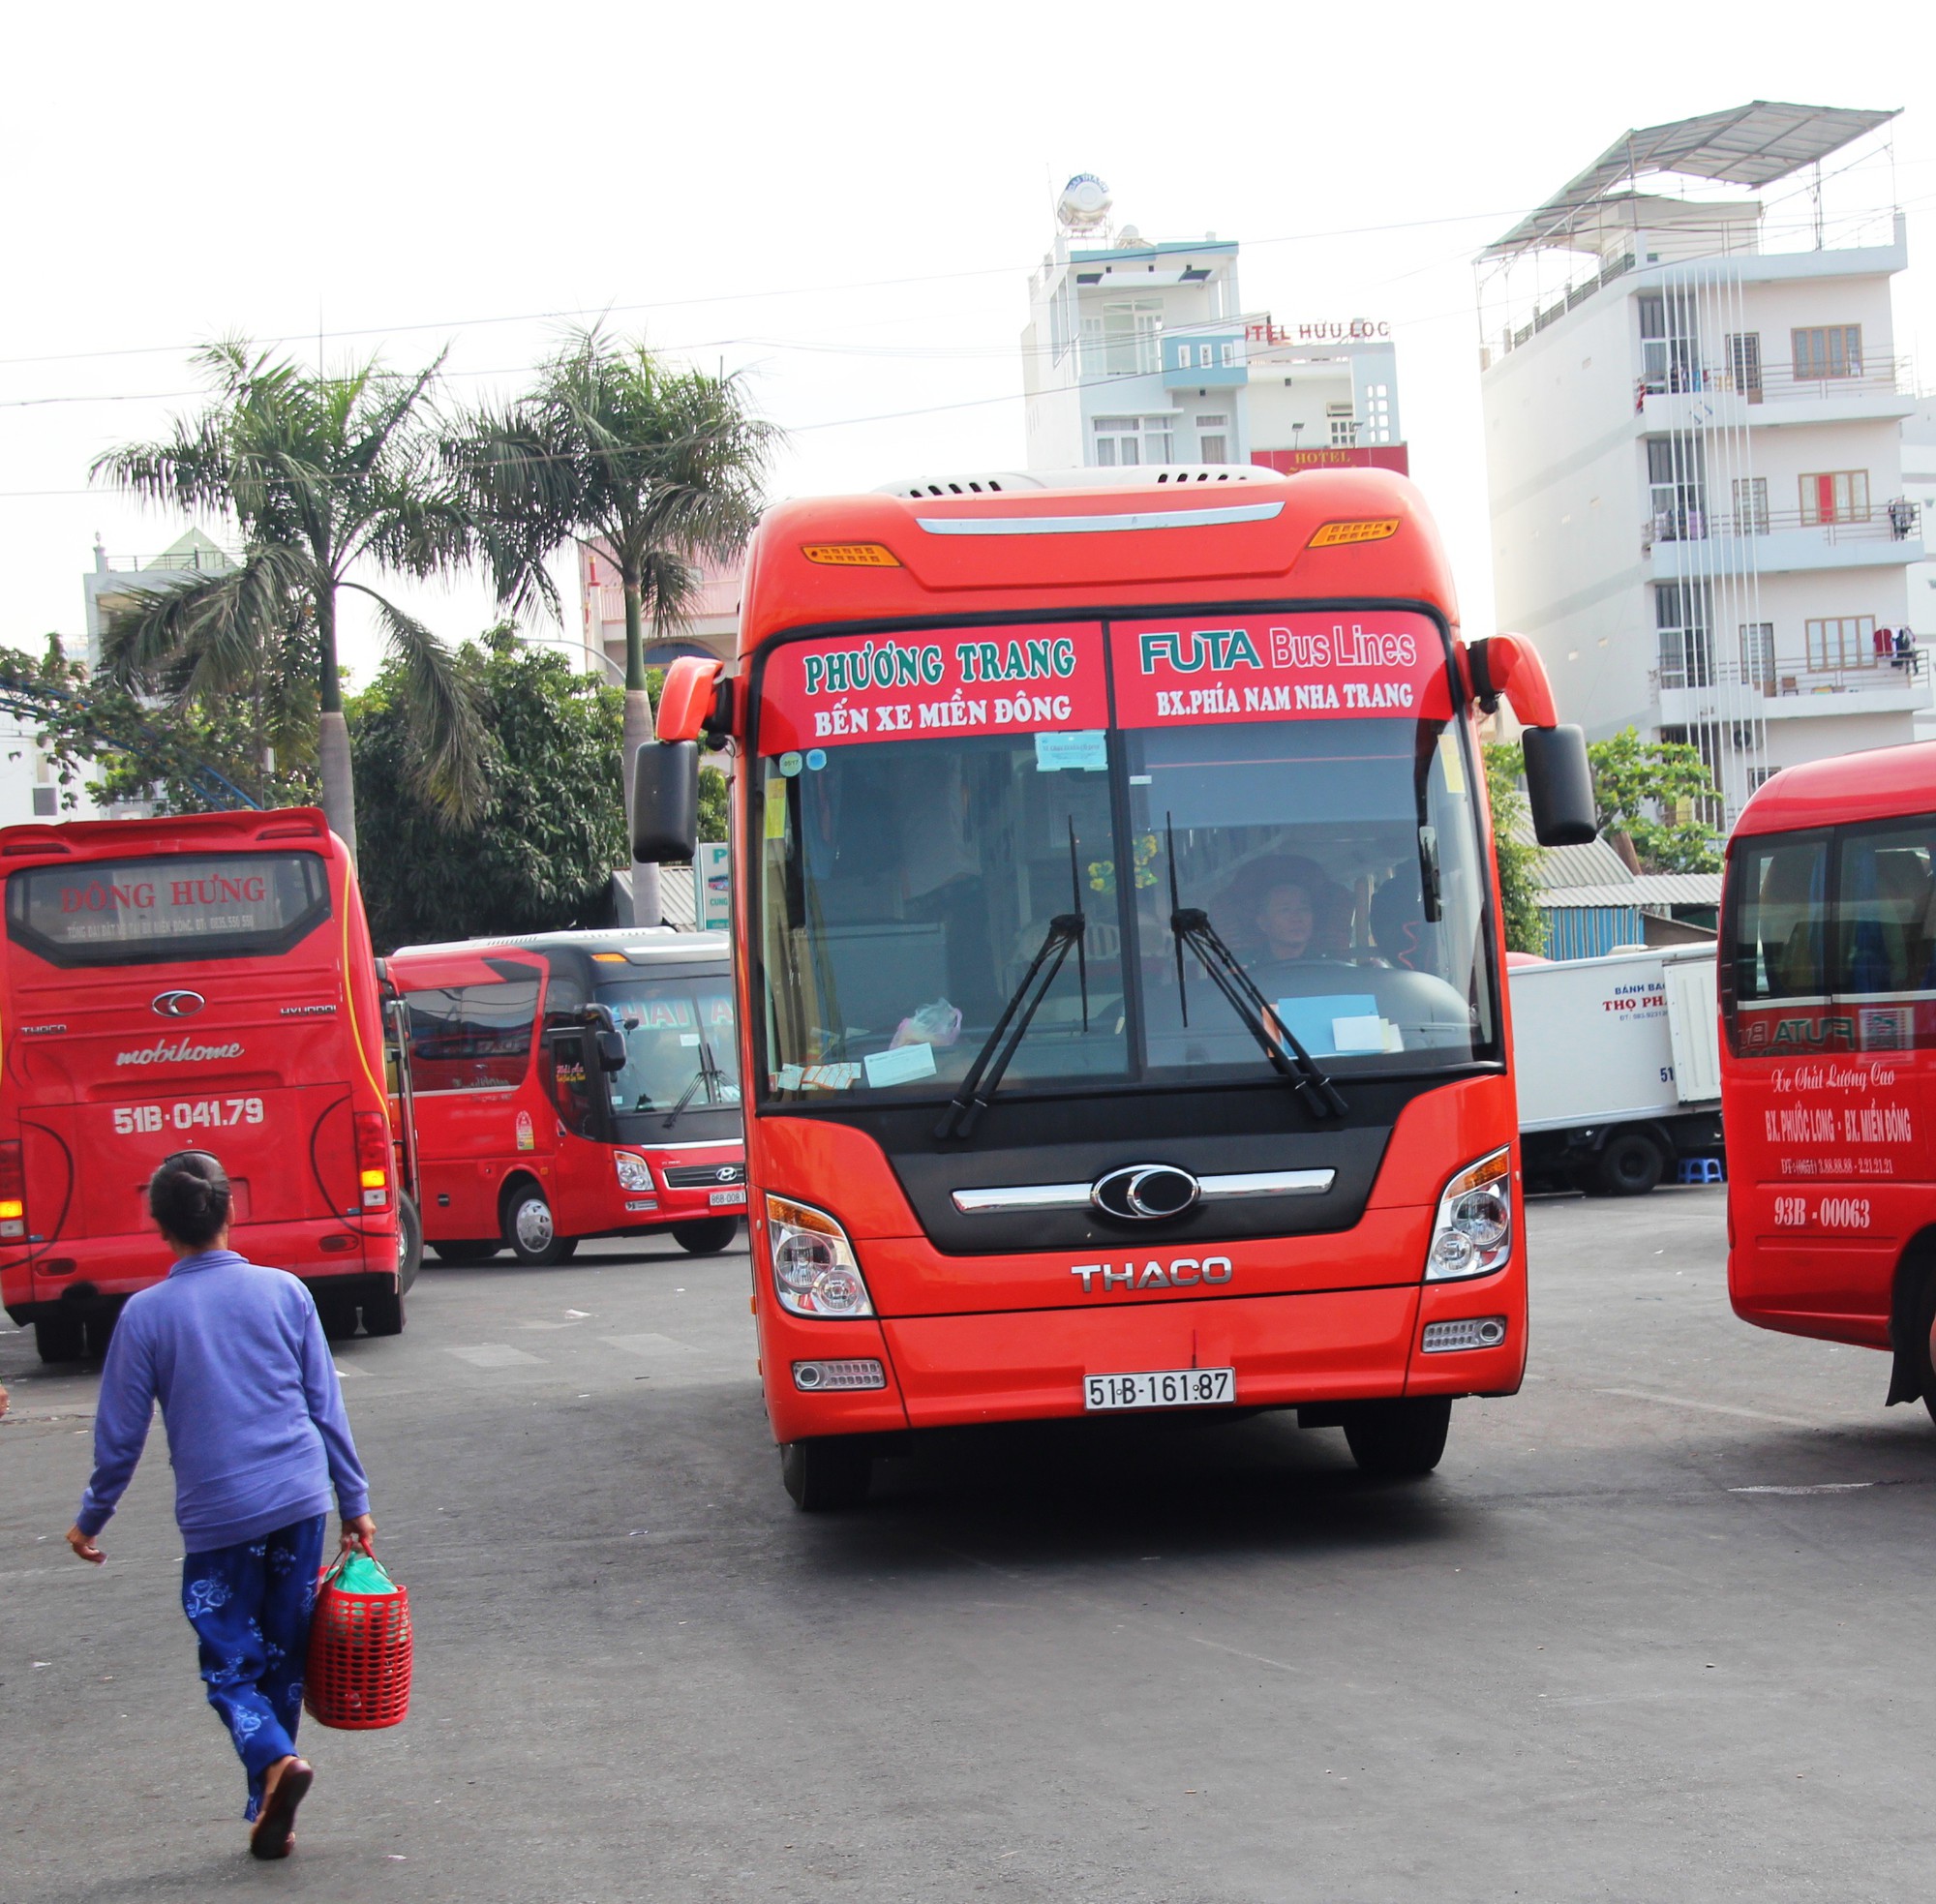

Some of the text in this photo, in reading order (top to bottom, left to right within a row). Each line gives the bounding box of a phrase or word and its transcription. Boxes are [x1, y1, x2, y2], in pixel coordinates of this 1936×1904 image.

[1295, 451, 1350, 464] HOTEL
[803, 637, 1076, 695] PHƯƠNG TRANG
[1138, 629, 1263, 676] FUTA
[814, 688, 1073, 737] BẾN XE MIỀN ĐÔNG
[1244, 685, 1291, 713] NAM
[1295, 683, 1341, 710] NHA
[1343, 682, 1413, 709] TRANG
[60, 873, 266, 914] ĐÔNG HƯNG
[1602, 995, 1667, 1012] THỌ PH
[1615, 983, 1645, 995] BÁNH
[116, 1038, 245, 1066] mobihome
[1660, 1067, 1674, 1082] 51
[1771, 1068, 1791, 1093] Xe
[1870, 1061, 1894, 1087] Cao
[1810, 1108, 1835, 1142] LONG
[1885, 1102, 1912, 1142] ĐÔNG
[1774, 1196, 1806, 1226] 93B
[1820, 1197, 1870, 1228] 00063
[1071, 1256, 1232, 1293] THACO
